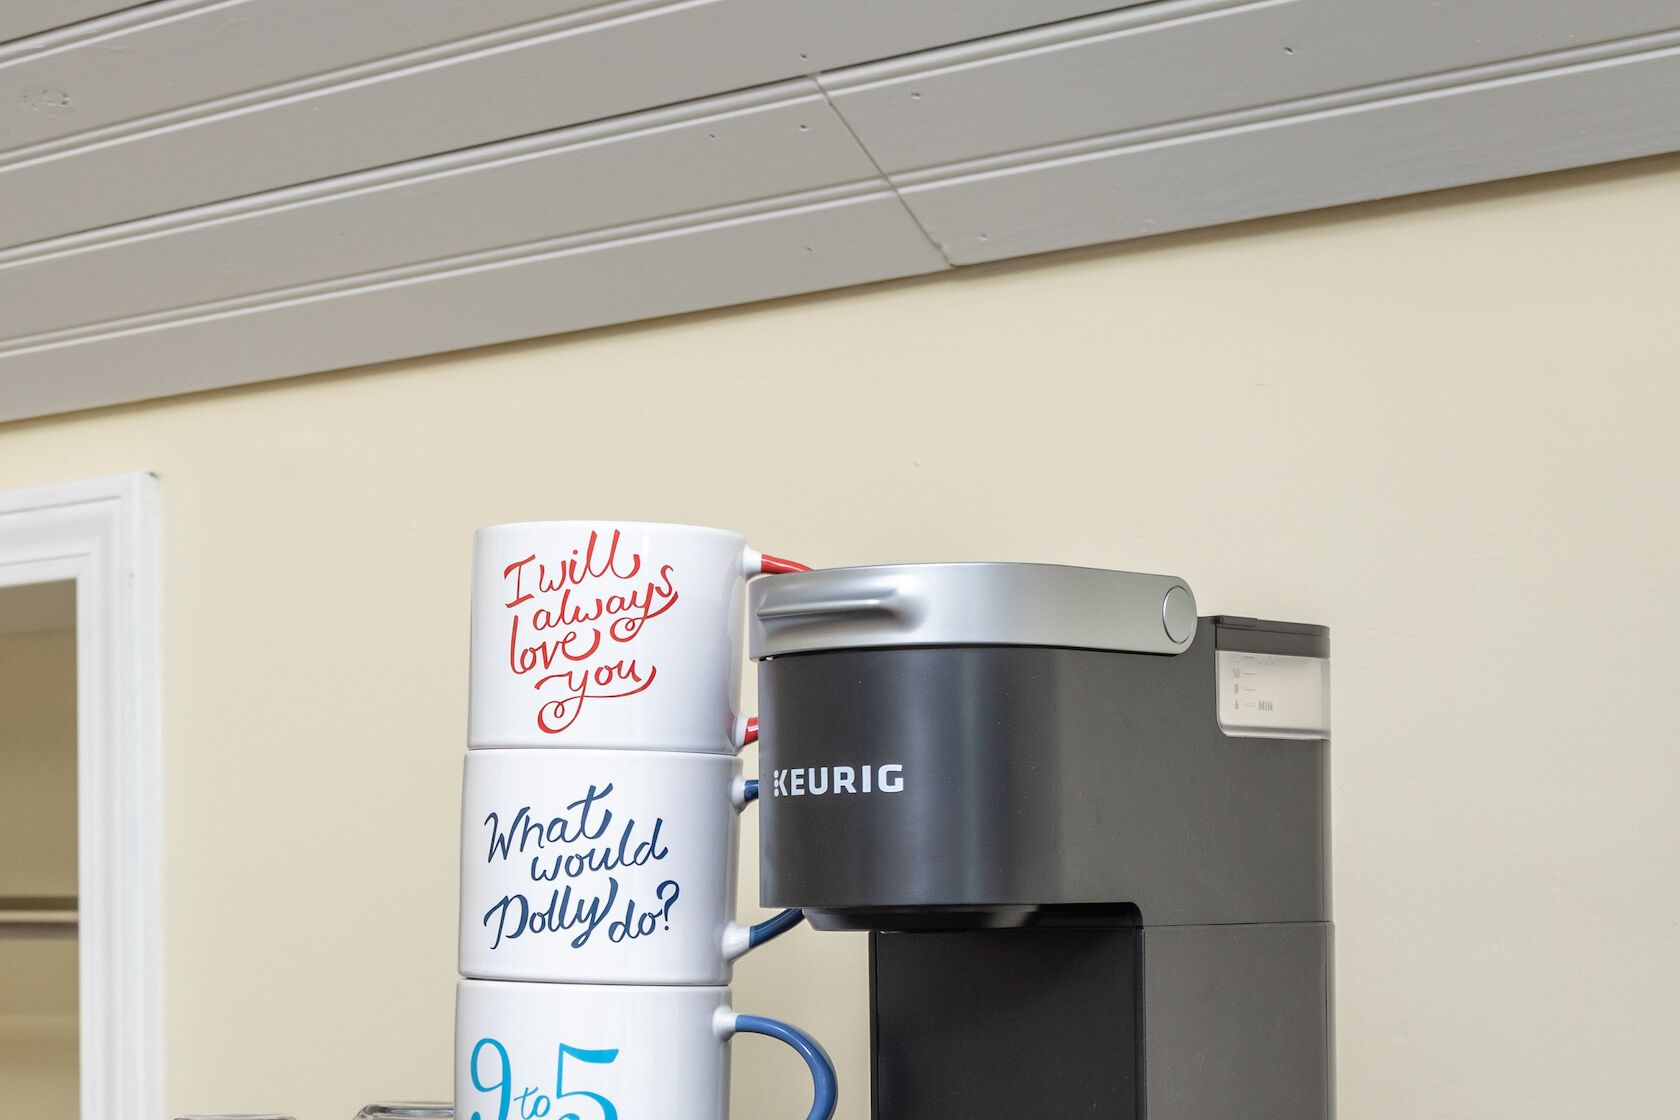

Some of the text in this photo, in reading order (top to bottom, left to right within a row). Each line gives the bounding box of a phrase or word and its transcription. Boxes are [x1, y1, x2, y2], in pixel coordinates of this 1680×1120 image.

[504, 529, 641, 608] I will
[532, 564, 679, 642] always
[510, 615, 601, 675] love
[534, 659, 657, 734] you
[1258, 701, 1273, 712] MIN
[773, 764, 904, 798] KEURIG
[484, 783, 613, 864] What
[531, 817, 669, 881] would
[483, 877, 680, 950] Dolly do?
[513, 1086, 551, 1120] to
